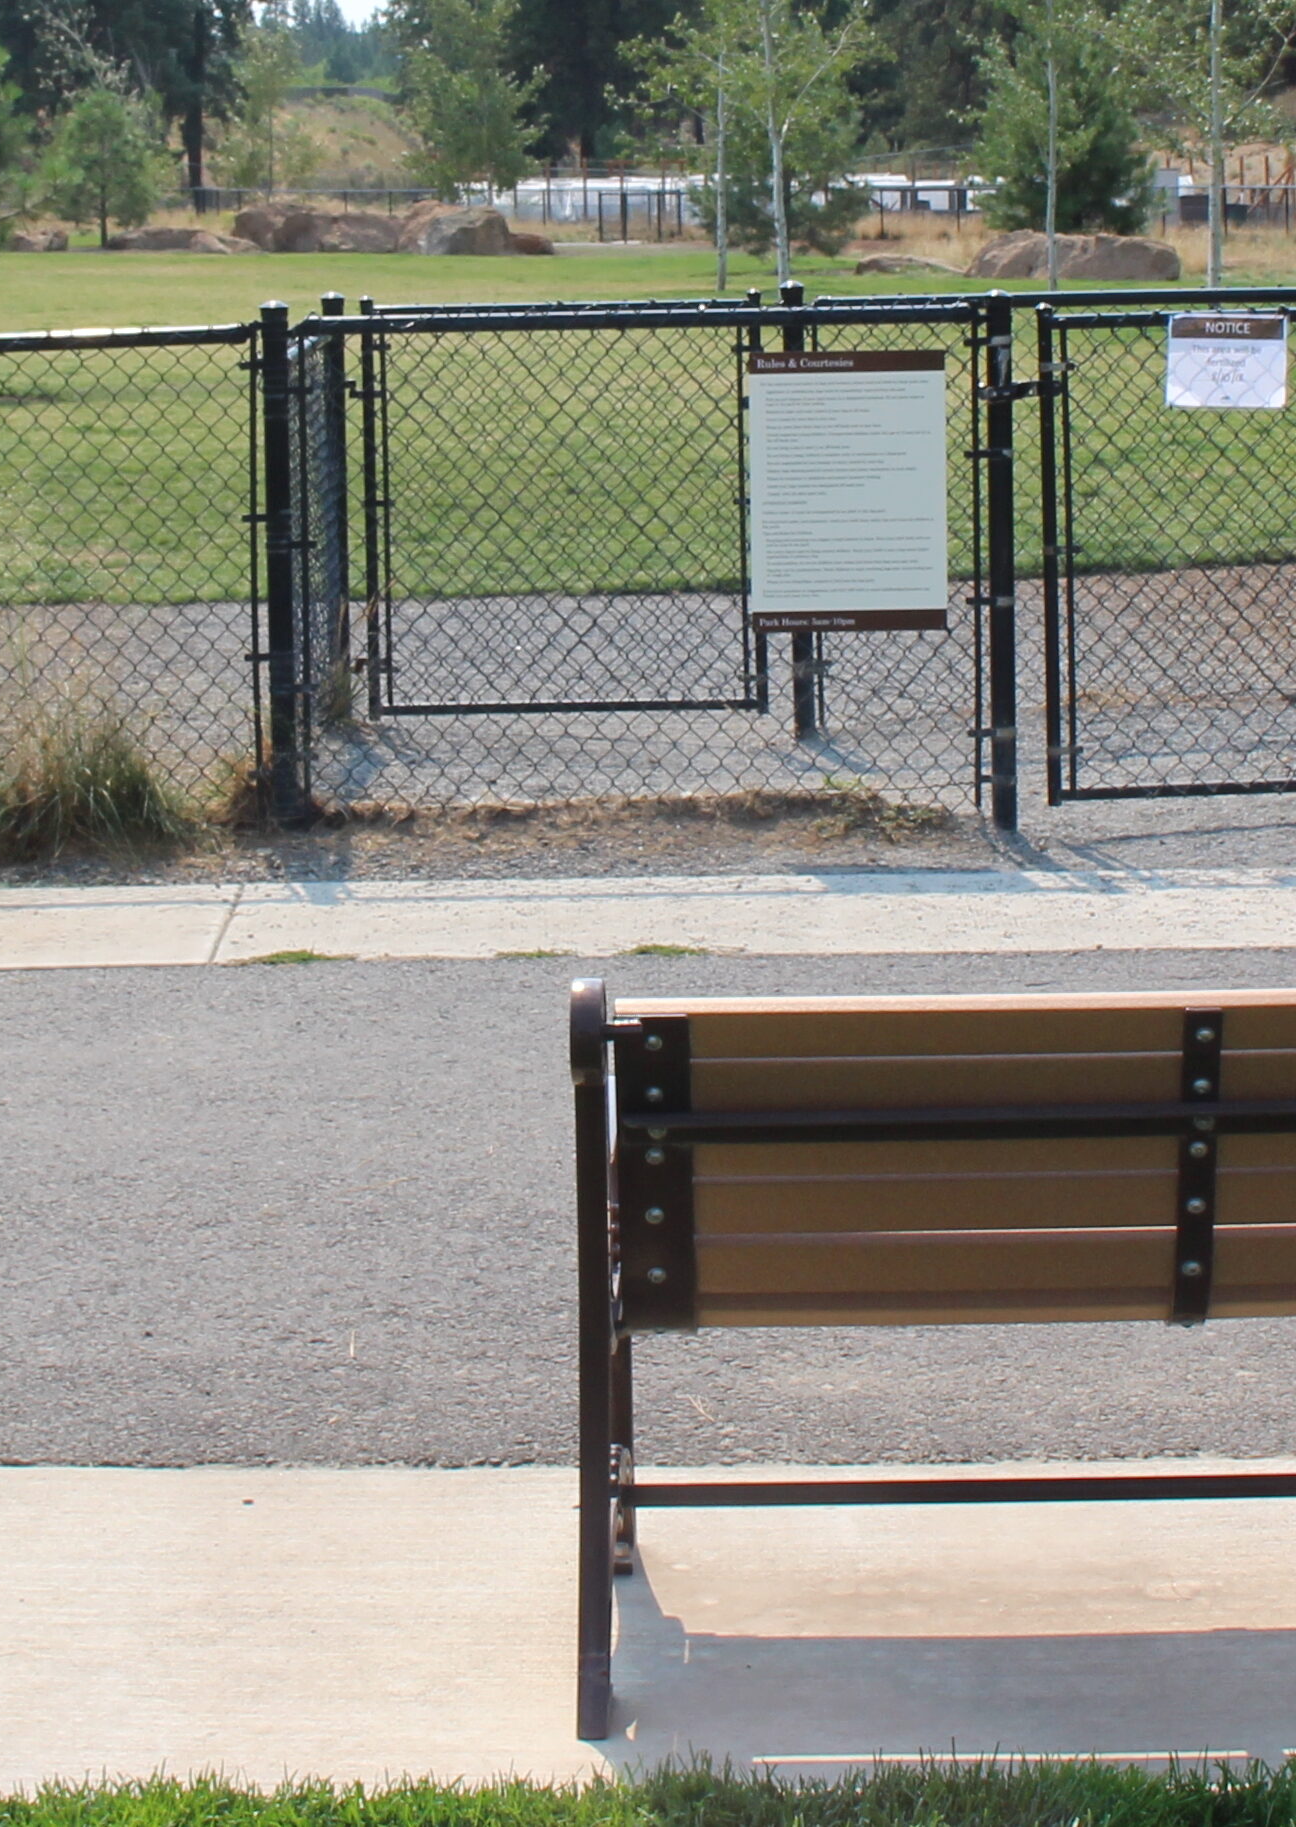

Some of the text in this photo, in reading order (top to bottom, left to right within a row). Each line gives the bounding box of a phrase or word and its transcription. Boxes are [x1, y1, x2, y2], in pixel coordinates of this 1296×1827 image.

[1206, 322, 1250, 333] NOTICE
[1193, 344, 1209, 352] This
[757, 357, 853, 368] Rules & Courtesies
[759, 618, 779, 626] Park
